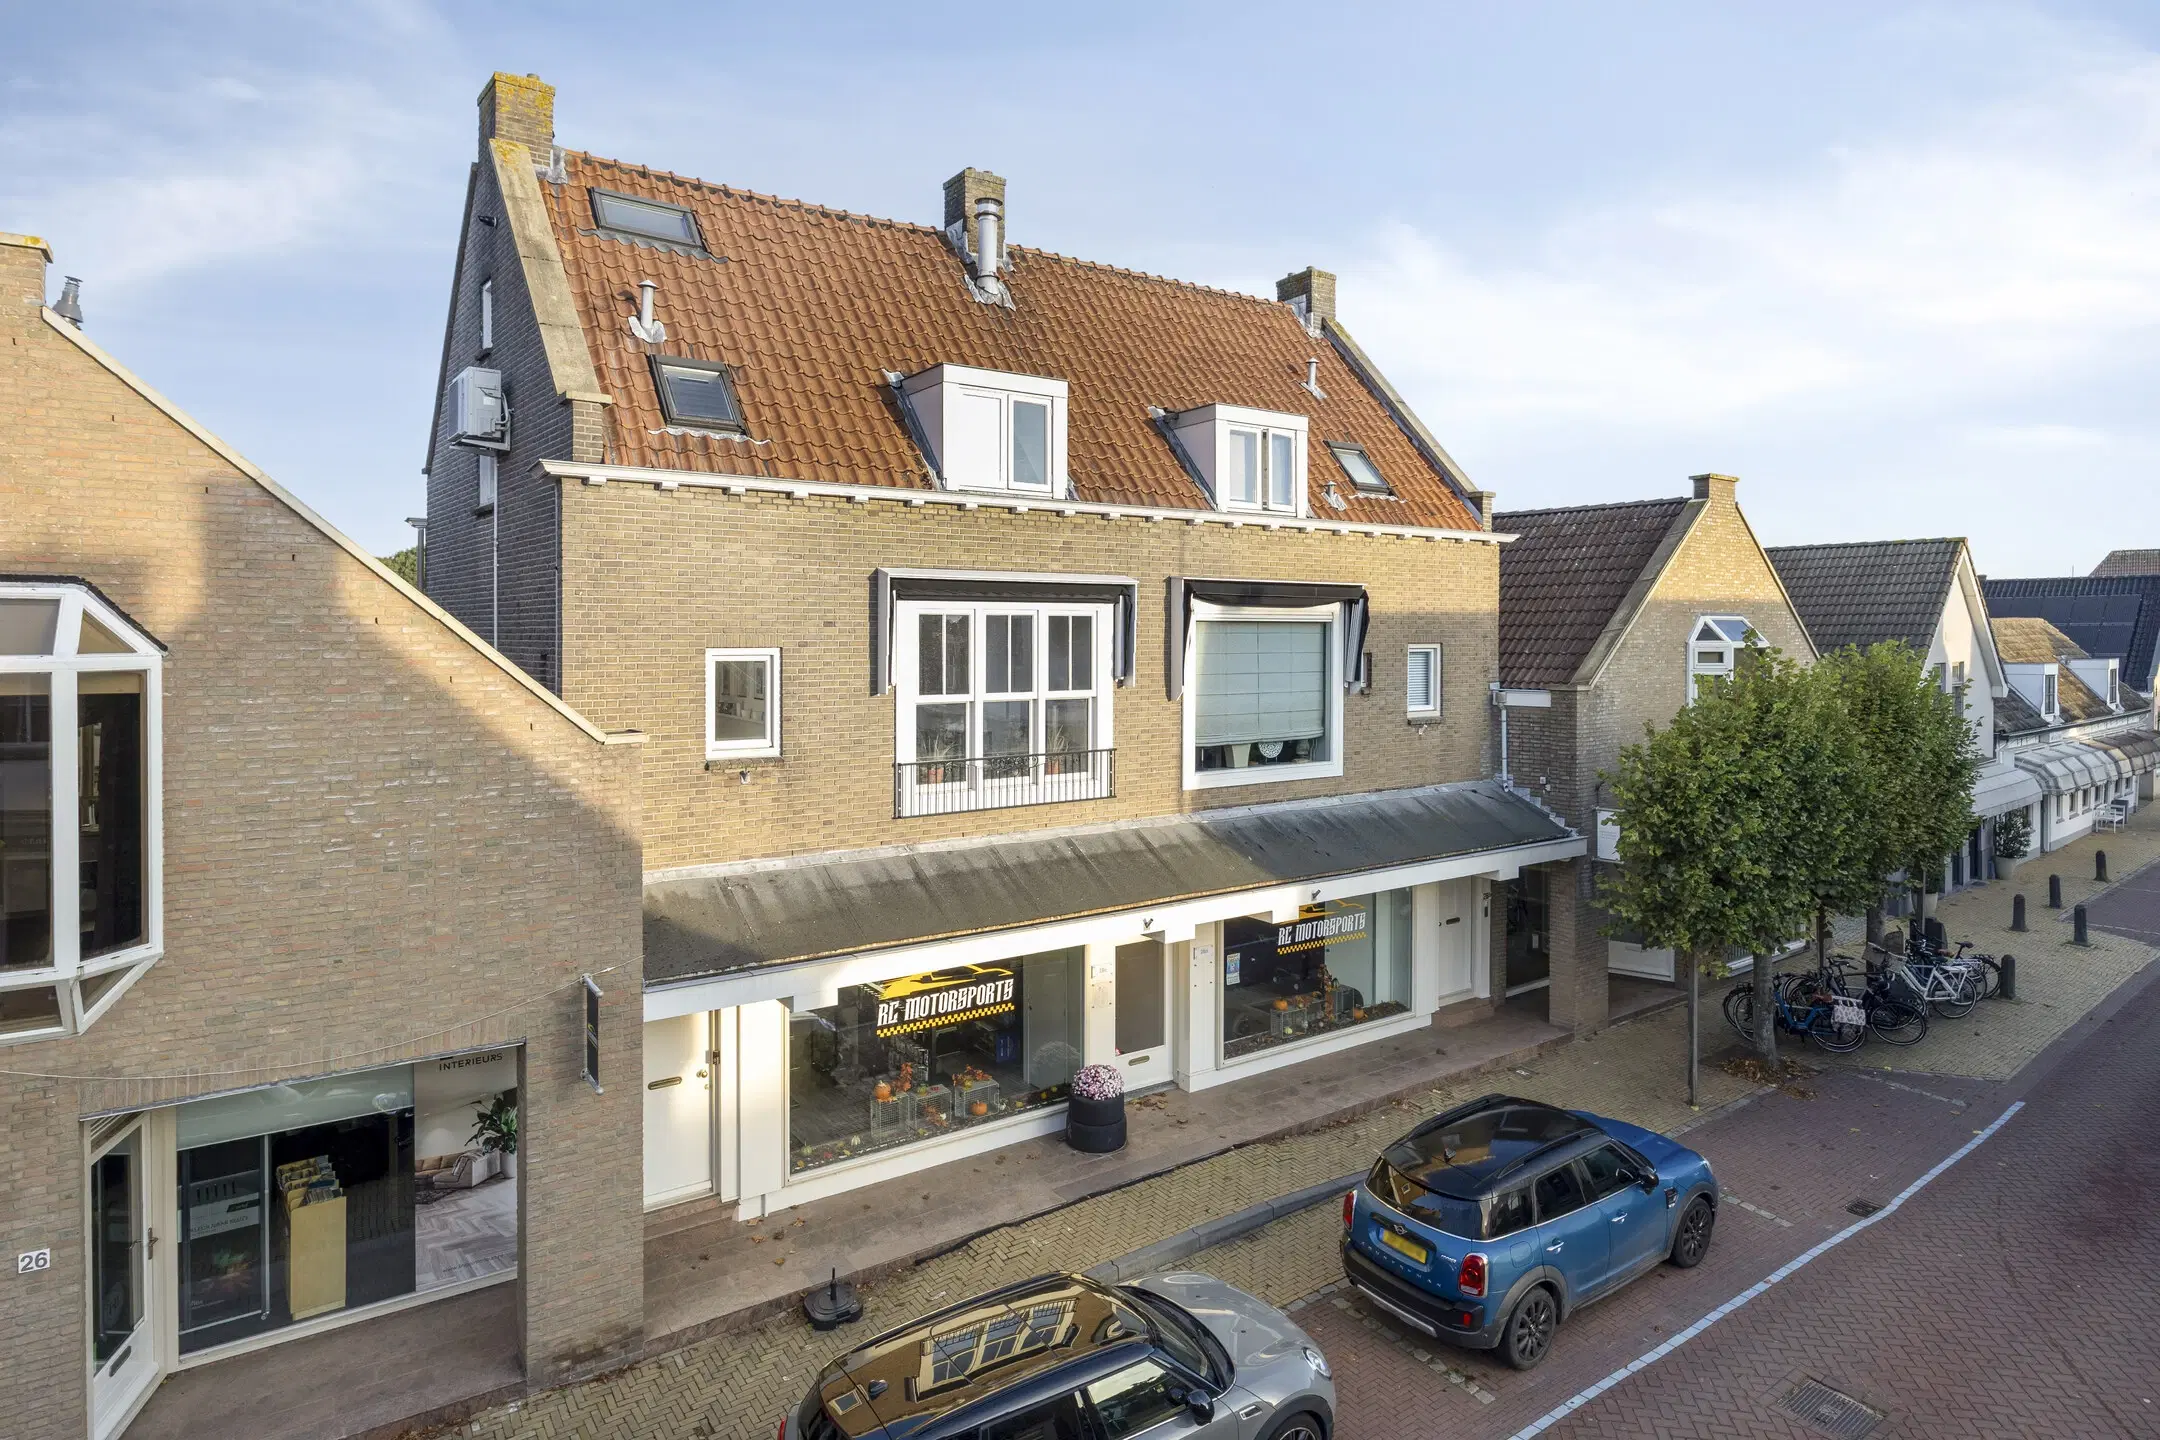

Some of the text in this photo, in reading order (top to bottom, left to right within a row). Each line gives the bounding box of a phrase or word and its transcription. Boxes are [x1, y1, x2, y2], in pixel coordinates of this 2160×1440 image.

[1295, 912, 1366, 942] MOTORSPORTS
[904, 979, 1014, 1020] MOTORSPORTS
[439, 1053, 503, 1071] INTERIEURS
[20, 1252, 48, 1271] 26
